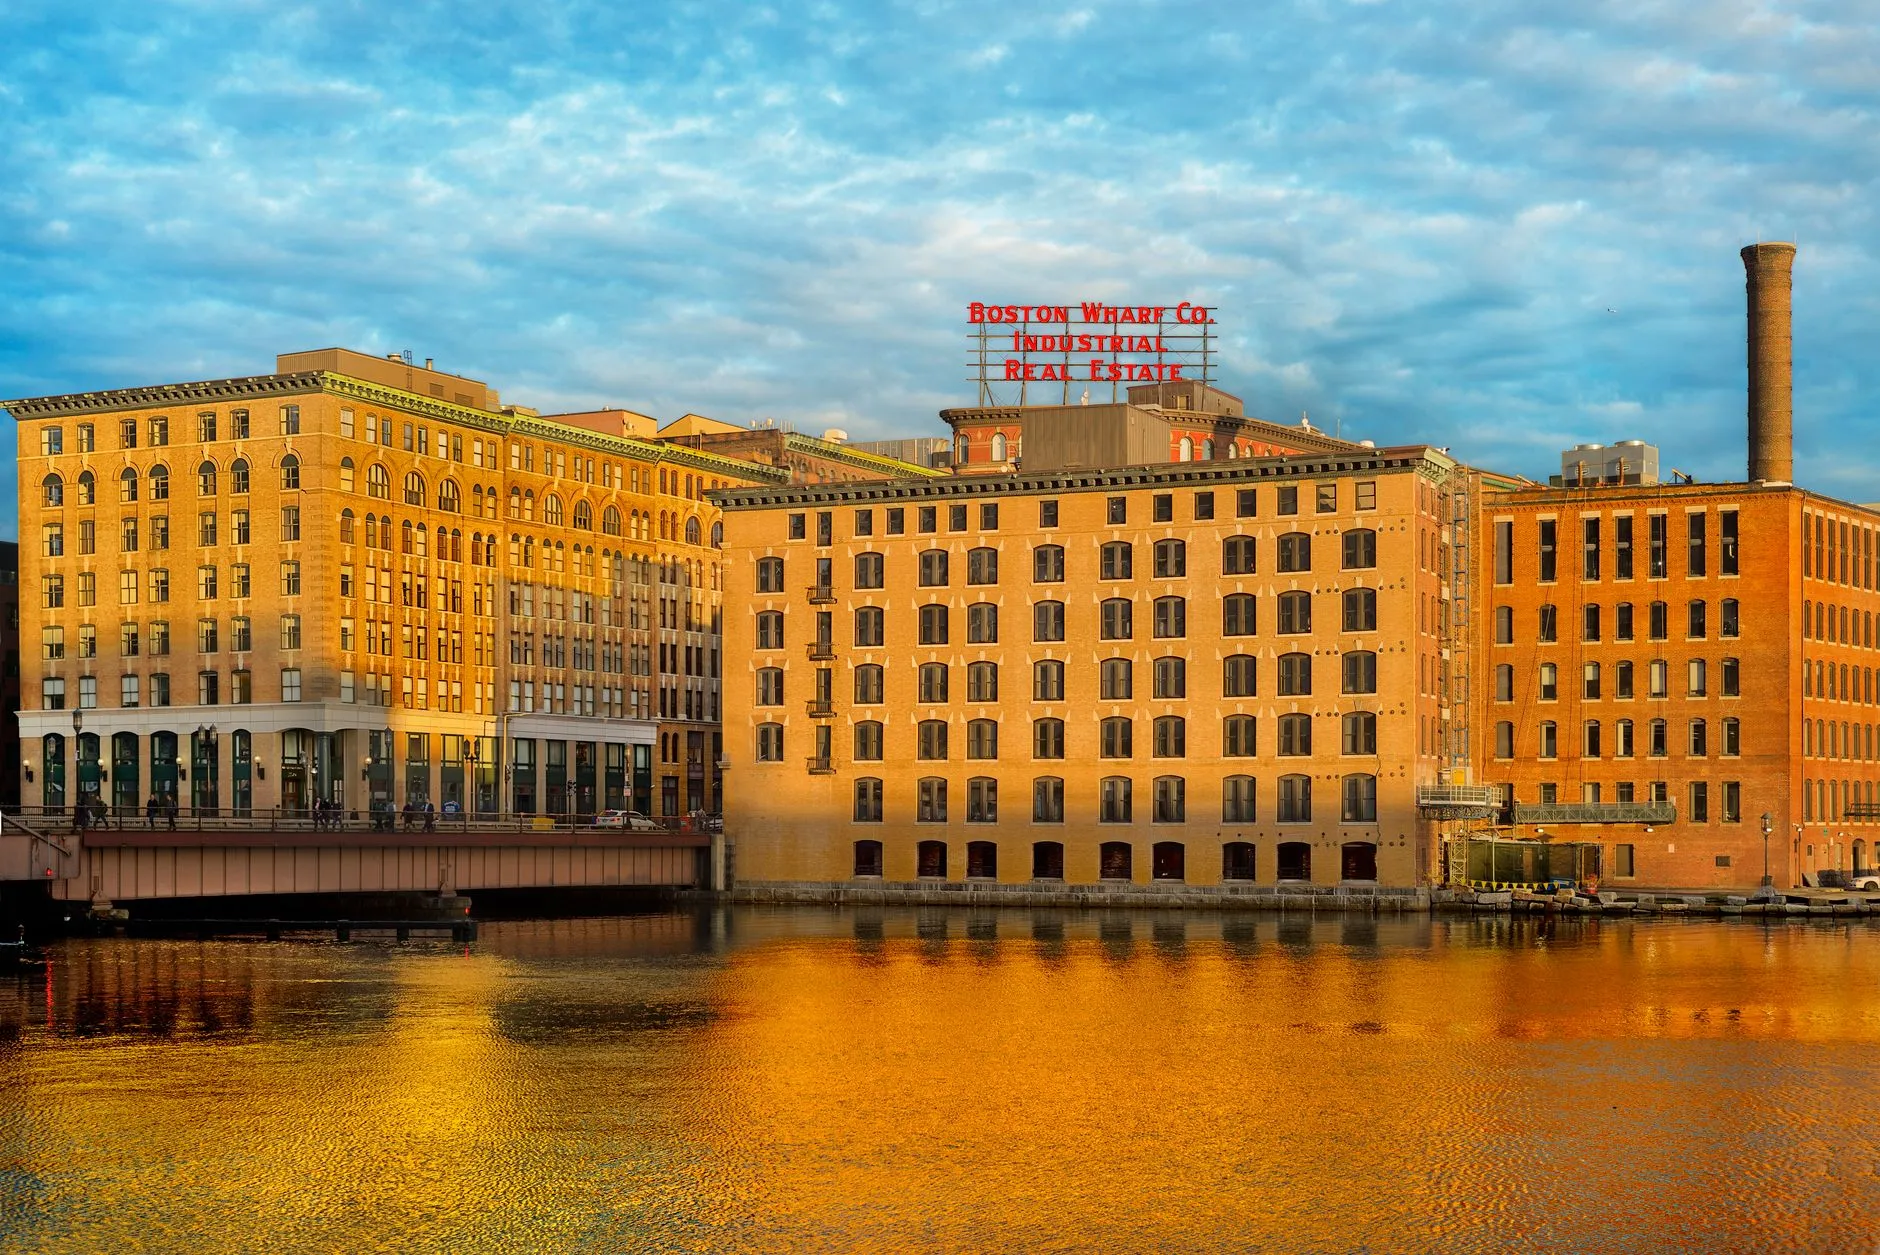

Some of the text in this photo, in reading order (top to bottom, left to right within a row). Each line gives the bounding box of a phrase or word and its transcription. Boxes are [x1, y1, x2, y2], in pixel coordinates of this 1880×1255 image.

[969, 302, 1068, 324] BOSTON
[1080, 302, 1165, 324] WHARF
[1013, 331, 1168, 352] INDUSTRIAL
[1004, 359, 1183, 381] REAL ESTATE
